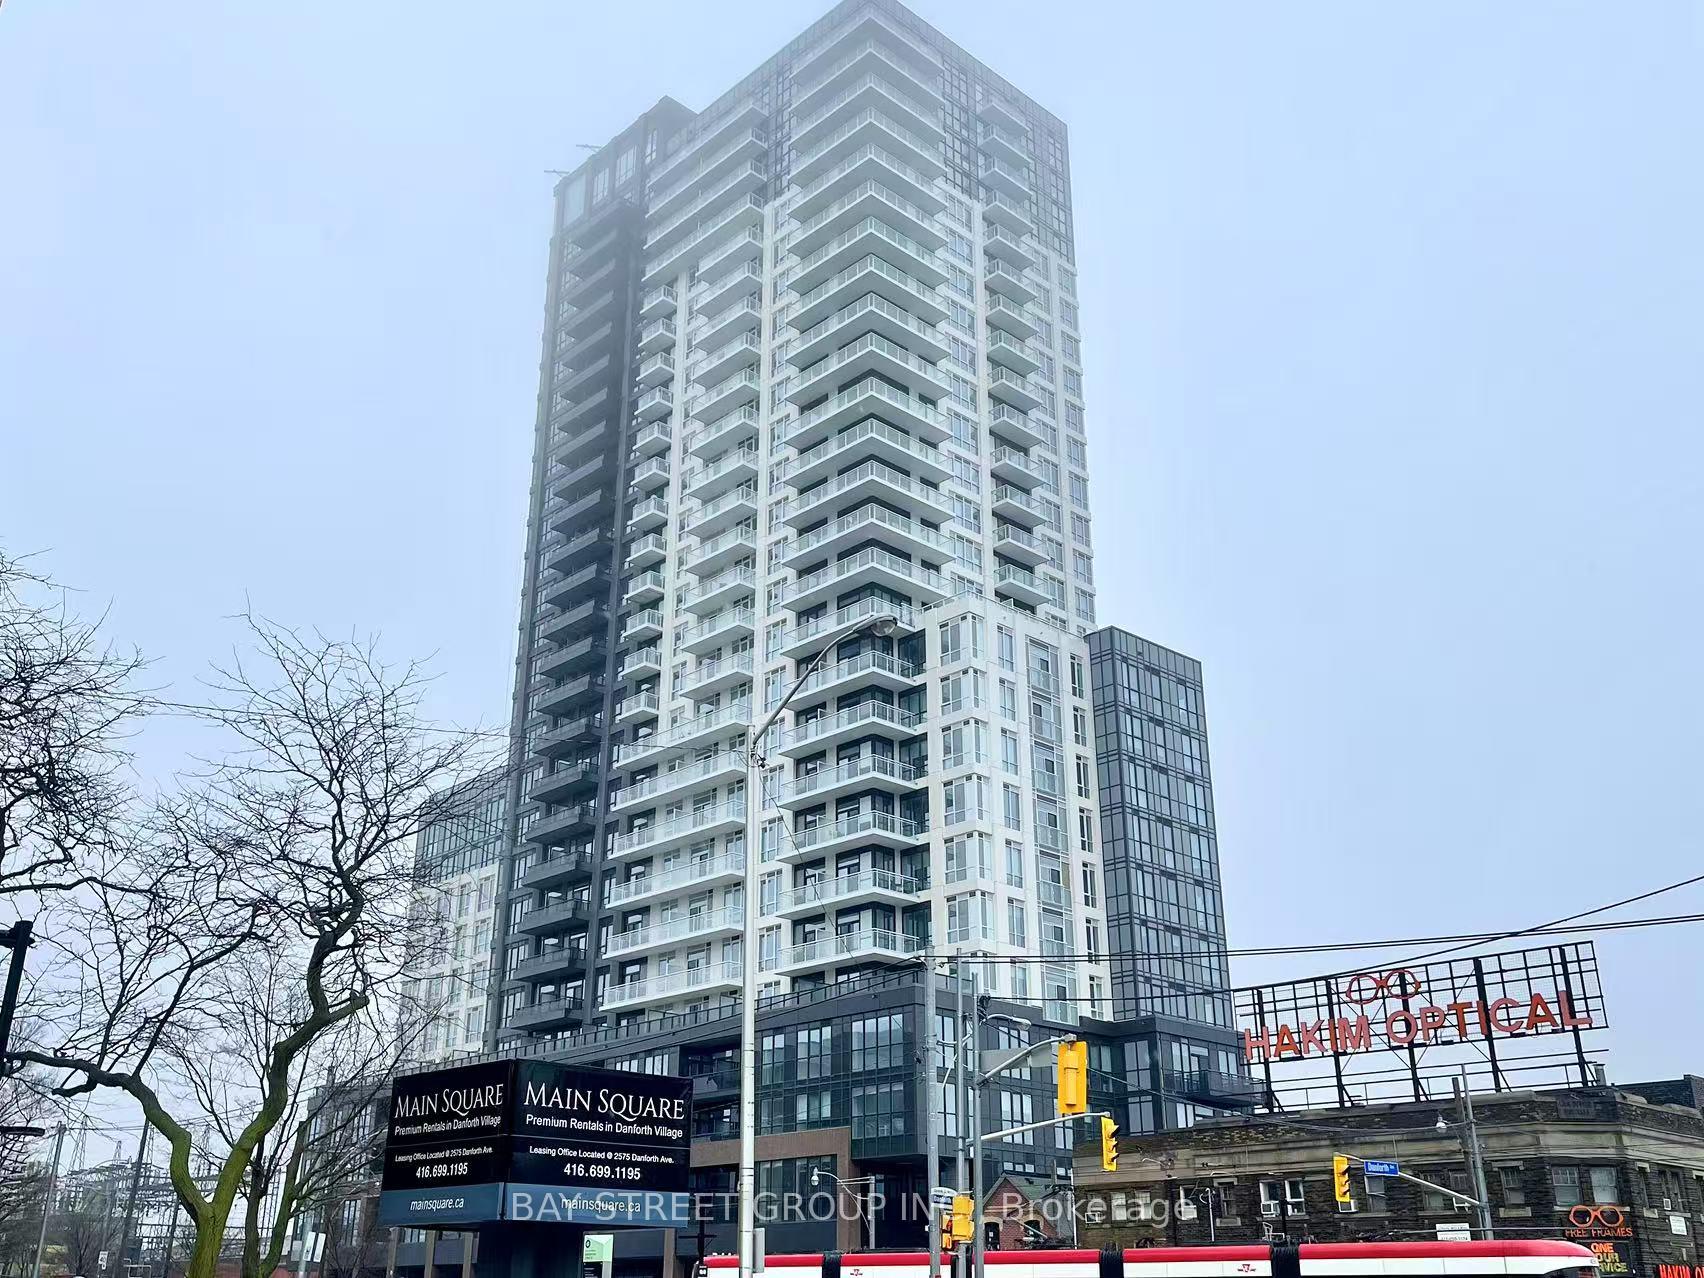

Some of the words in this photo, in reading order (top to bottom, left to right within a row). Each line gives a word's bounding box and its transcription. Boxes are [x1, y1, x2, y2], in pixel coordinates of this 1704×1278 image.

[1244, 1015, 1371, 1060] HAKIM
[1386, 990, 1594, 1043] OPTICAL
[394, 1094, 438, 1119] MAIN
[441, 1083, 504, 1117] SQUARE
[524, 1081, 592, 1112] MAIN
[597, 1088, 685, 1122] SQUARE
[394, 1125, 422, 1136] Premium
[423, 1121, 446, 1133] Rentals
[446, 1120, 452, 1130] in
[453, 1117, 480, 1130] Danforth
[480, 1115, 502, 1127] Village
[526, 1114, 567, 1129] Premium
[570, 1117, 604, 1132] Rentals
[605, 1121, 613, 1133] in
[615, 1122, 653, 1136] Danforth
[655, 1126, 683, 1140] Village
[395, 1154, 413, 1163] Leasing
[413, 1152, 427, 1161] Office
[426, 1150, 445, 1160] Located
[462, 1147, 483, 1156] Danforth
[529, 1146, 556, 1157] Leasing
[557, 1147, 578, 1158] Office
[578, 1150, 605, 1160] Located
[606, 1152, 613, 1160] @
[613, 1152, 631, 1162] 2575
[631, 1154, 659, 1164] Danforth
[660, 1156, 675, 1165] Ave.
[416, 1162, 468, 1178] 416.699.1195
[563, 1163, 641, 1180] 416.699.1195
[410, 1198, 465, 1212] mainsquare.ca
[561, 1197, 641, 1214] mainsquare.ca
[1565, 1228, 1588, 1238] FREE
[1591, 1226, 1634, 1238] FRAMES
[1591, 1242, 1615, 1253] ONE
[1595, 1252, 1620, 1263] OUR
